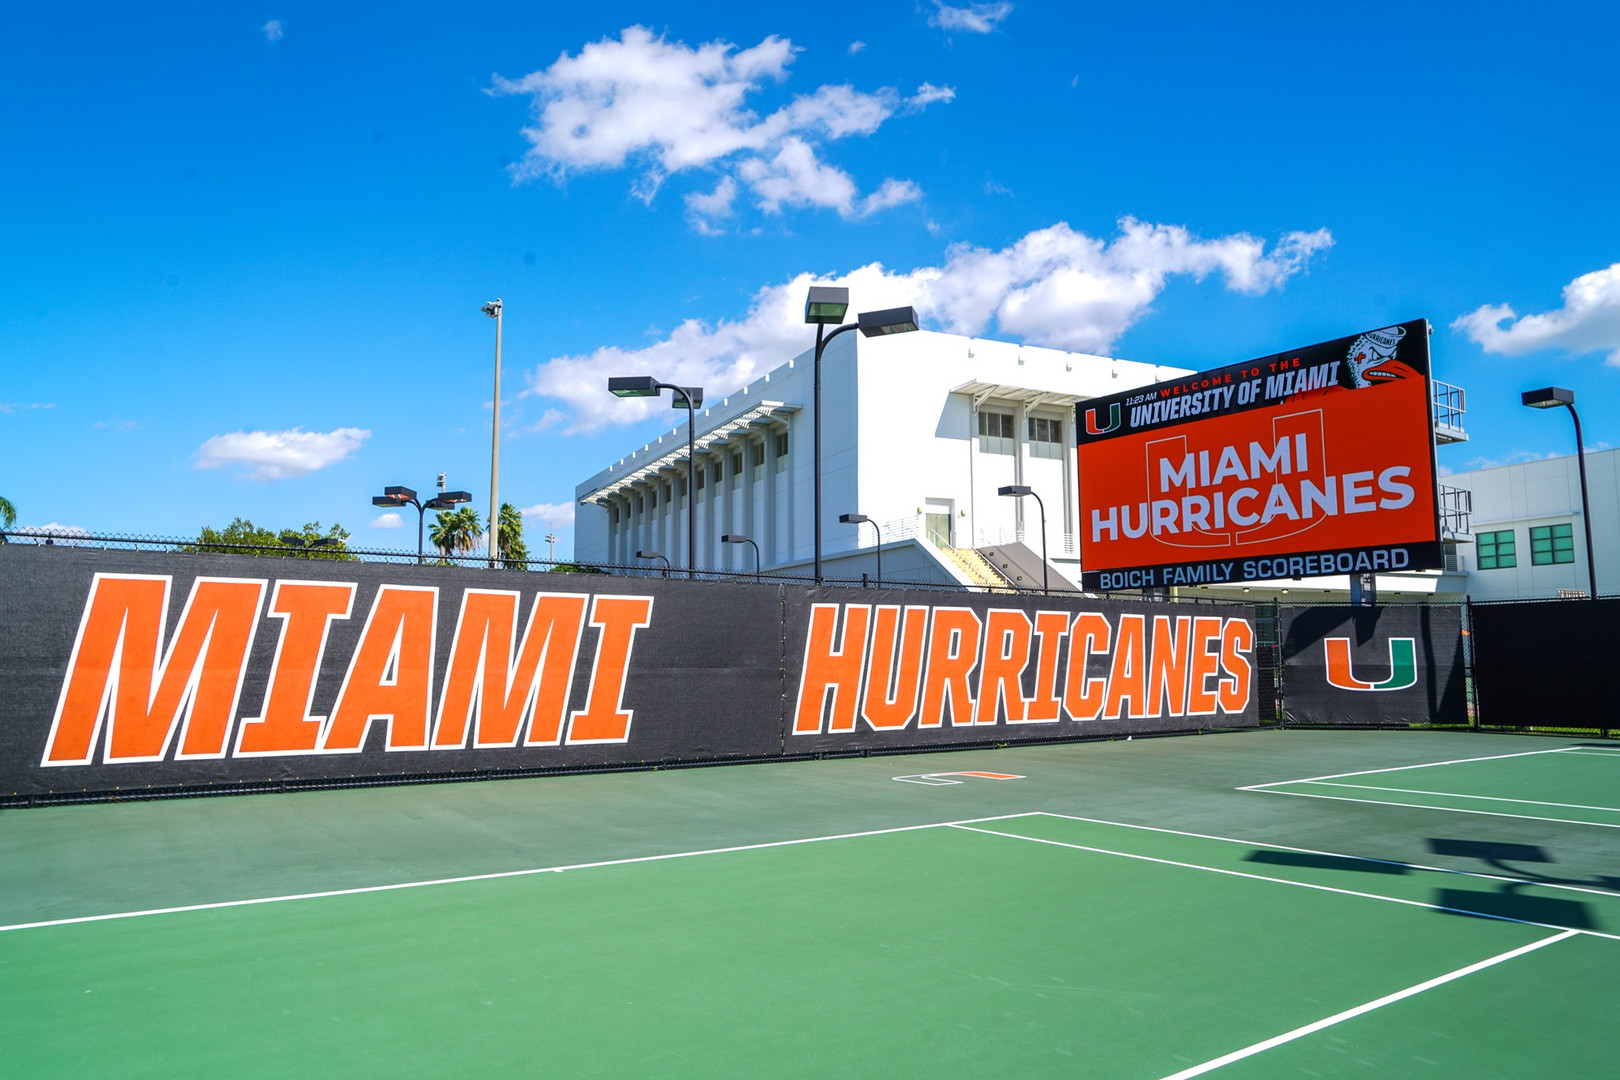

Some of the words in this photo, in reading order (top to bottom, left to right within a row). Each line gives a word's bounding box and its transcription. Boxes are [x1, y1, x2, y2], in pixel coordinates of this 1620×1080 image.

[1125, 394, 1145, 407] 11:23
[1145, 391, 1158, 402] AM
[1130, 384, 1236, 428] UNIVERSITY
[1237, 377, 1262, 405] OF
[1265, 360, 1341, 400] MIAMI
[1160, 374, 1232, 398] WELCOME
[1241, 367, 1260, 379] TO
[1269, 357, 1301, 372] THE
[1085, 402, 1121, 435] U
[1159, 432, 1308, 493] MIAMI
[1091, 465, 1416, 543] HURRICANES
[1099, 570, 1155, 590] BOICH
[1163, 562, 1234, 585] FAMILY
[1243, 548, 1410, 580] SCOREBOARD
[40, 572, 655, 767] MIAMI
[792, 602, 1255, 736] HURRICANES
[1324, 637, 1419, 692] U
